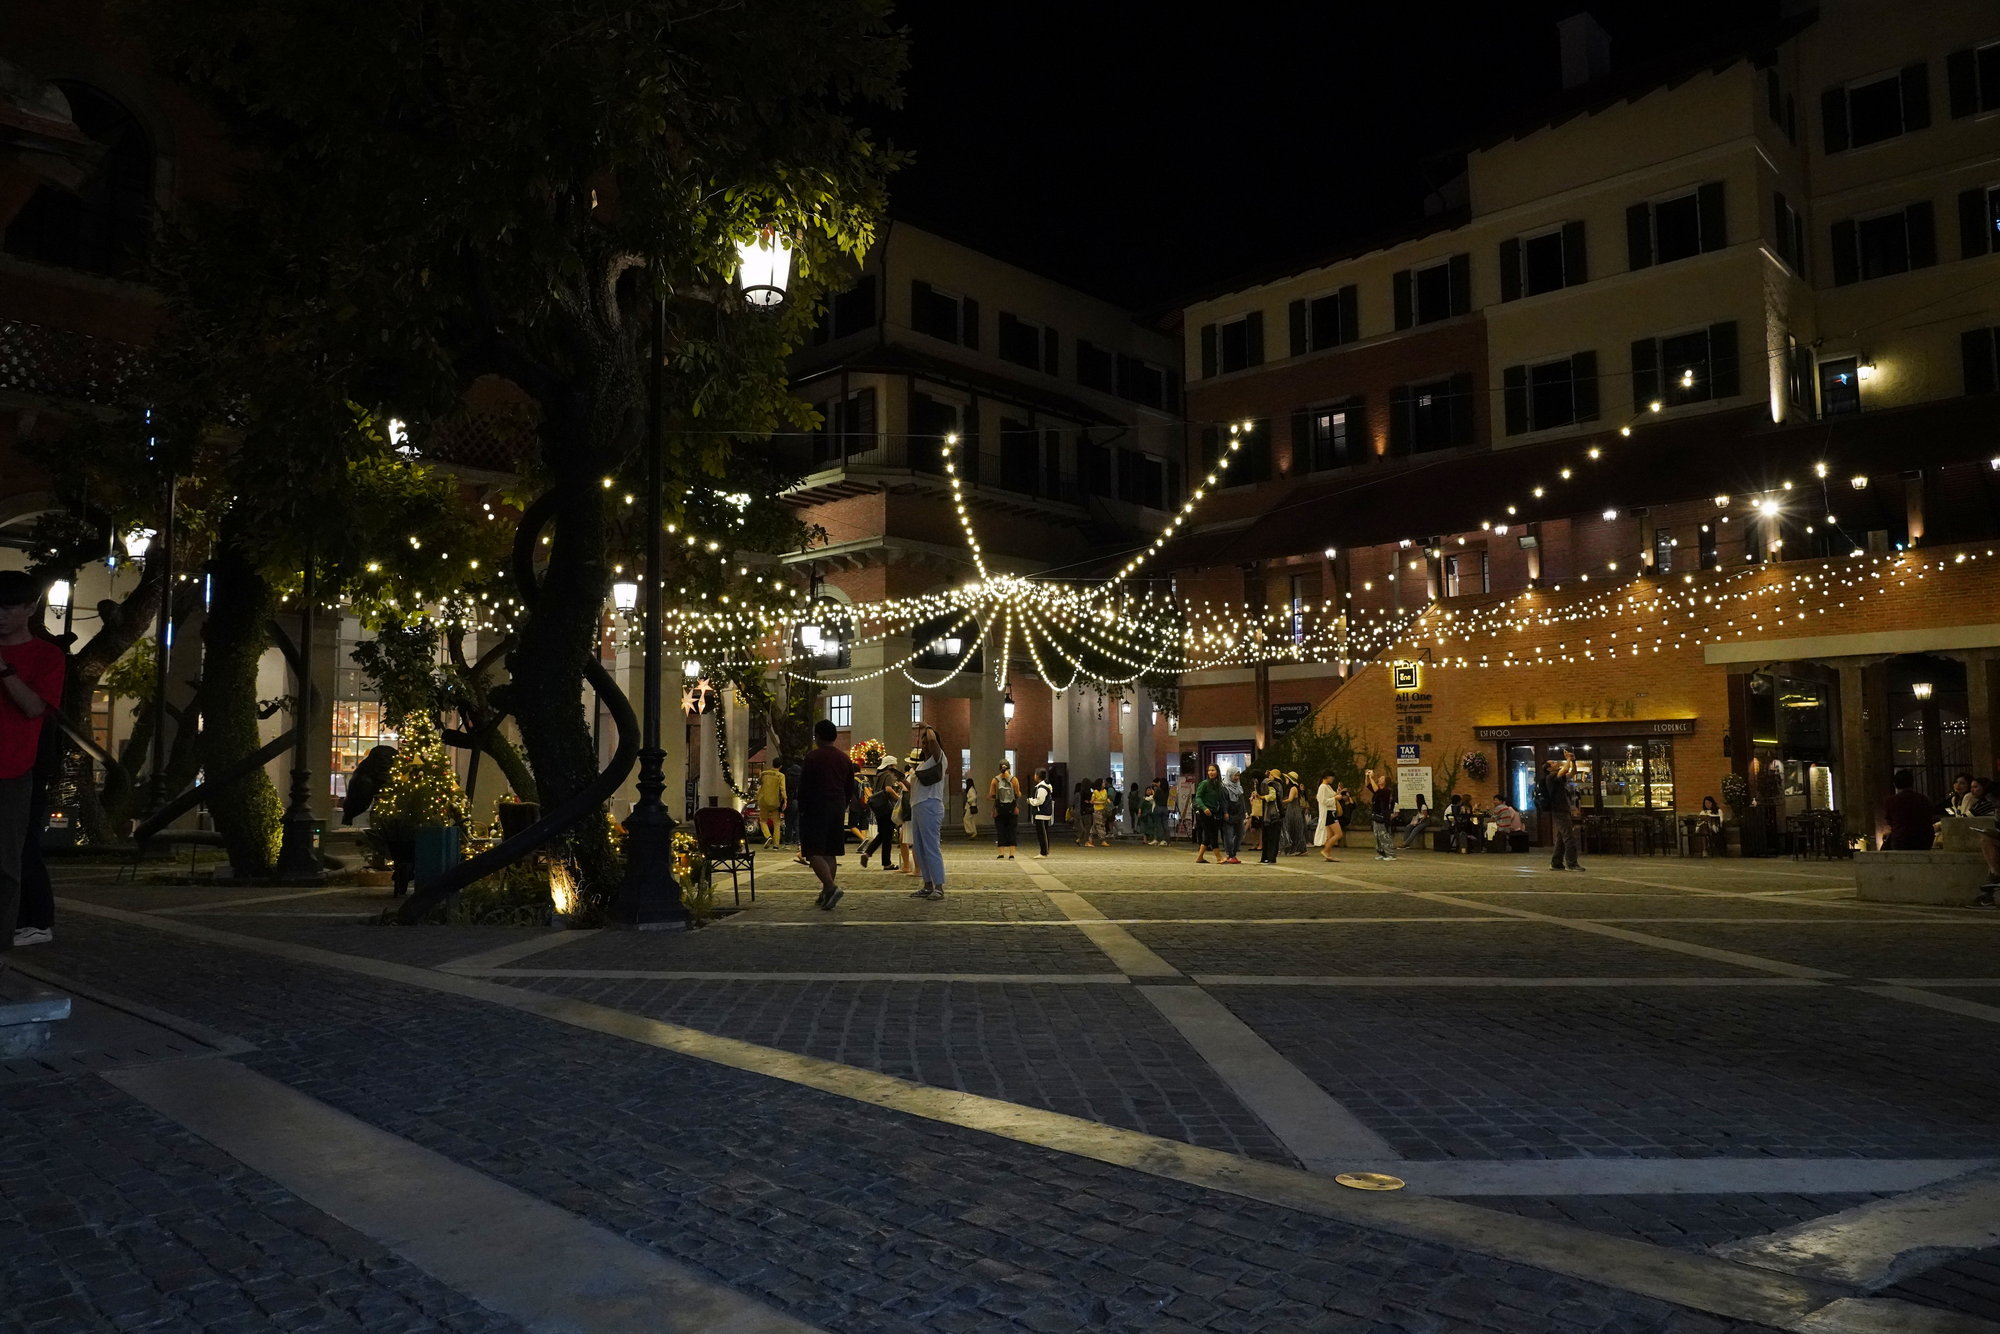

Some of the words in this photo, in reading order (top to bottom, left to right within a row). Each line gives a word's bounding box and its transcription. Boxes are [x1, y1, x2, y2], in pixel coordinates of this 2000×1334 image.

[1396, 692, 1409, 702] All
[1412, 692, 1432, 701] One
[1510, 703, 1535, 721] LA
[1563, 698, 1634, 720] PIZZA
[1400, 746, 1415, 755] TAX
